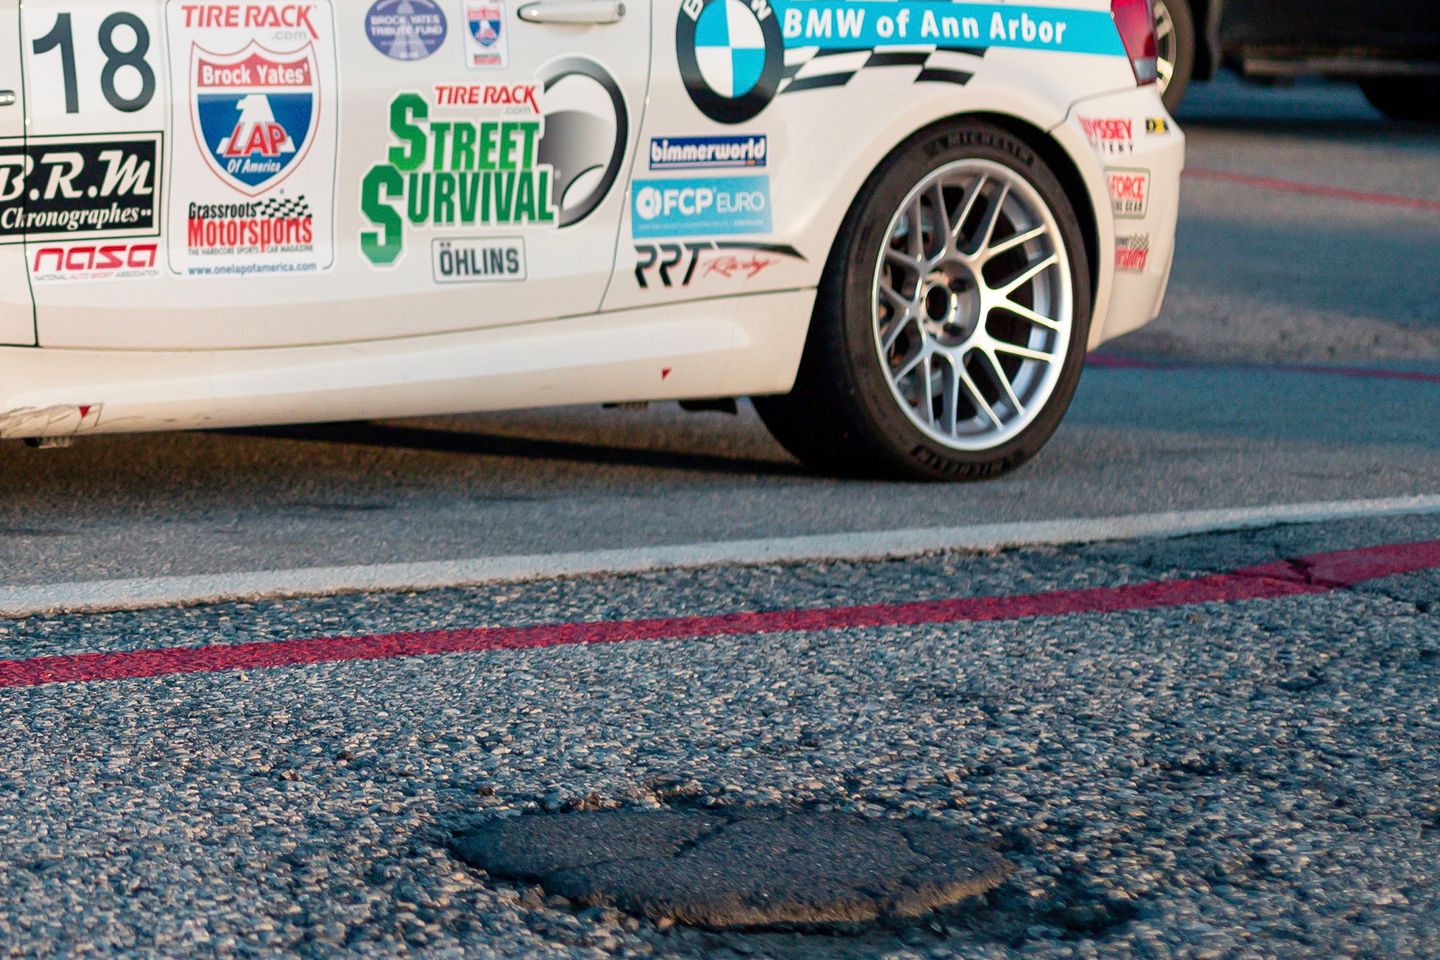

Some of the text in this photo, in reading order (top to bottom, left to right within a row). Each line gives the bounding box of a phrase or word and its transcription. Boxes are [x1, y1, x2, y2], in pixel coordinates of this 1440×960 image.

[181, 4, 320, 41] TIRE RACK
[271, 28, 308, 41] .com
[783, 6, 1067, 45] BMW of Ann Arbor
[32, 10, 157, 114] 18
[202, 64, 309, 85] Brock Yates'
[435, 85, 539, 114] TIRE RACK
[222, 121, 288, 157] LAP
[651, 138, 766, 162] bimmerworld
[227, 158, 282, 174] Of America
[188, 201, 258, 220] Grassroots
[663, 188, 766, 216] FCP EURO
[0, 204, 140, 231] Chronographes
[187, 216, 314, 254] Motorsports
[33, 243, 158, 273] nasa
[188, 244, 314, 256] THE HARDCORE SPORTS CAR MAGAZINE
[439, 242, 520, 277] ÖHLINS
[188, 261, 317, 277] www.onelapofamerica.com
[633, 243, 714, 289] RRT
